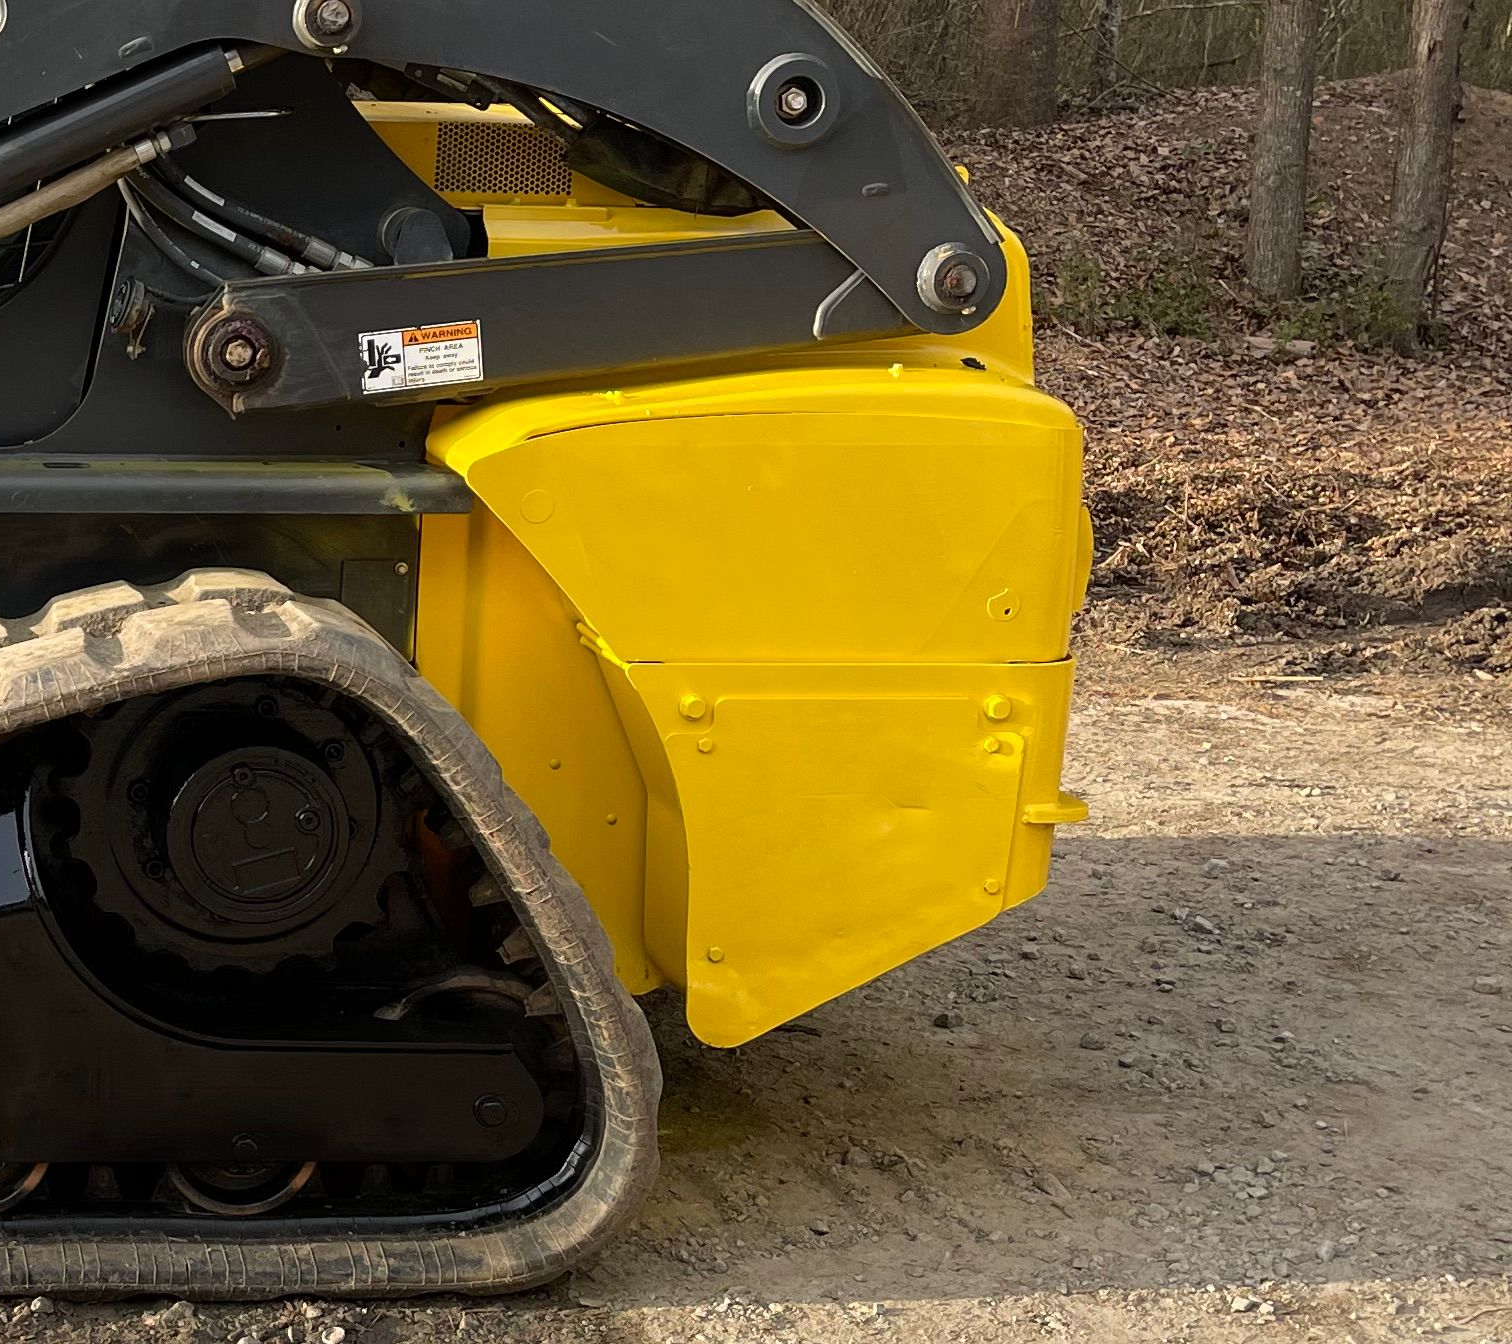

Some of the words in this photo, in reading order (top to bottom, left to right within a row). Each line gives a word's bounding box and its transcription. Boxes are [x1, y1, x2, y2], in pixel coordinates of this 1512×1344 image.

[420, 327, 472, 341] WARNING
[419, 345, 441, 353] PINCH
[443, 343, 464, 351] AREA
